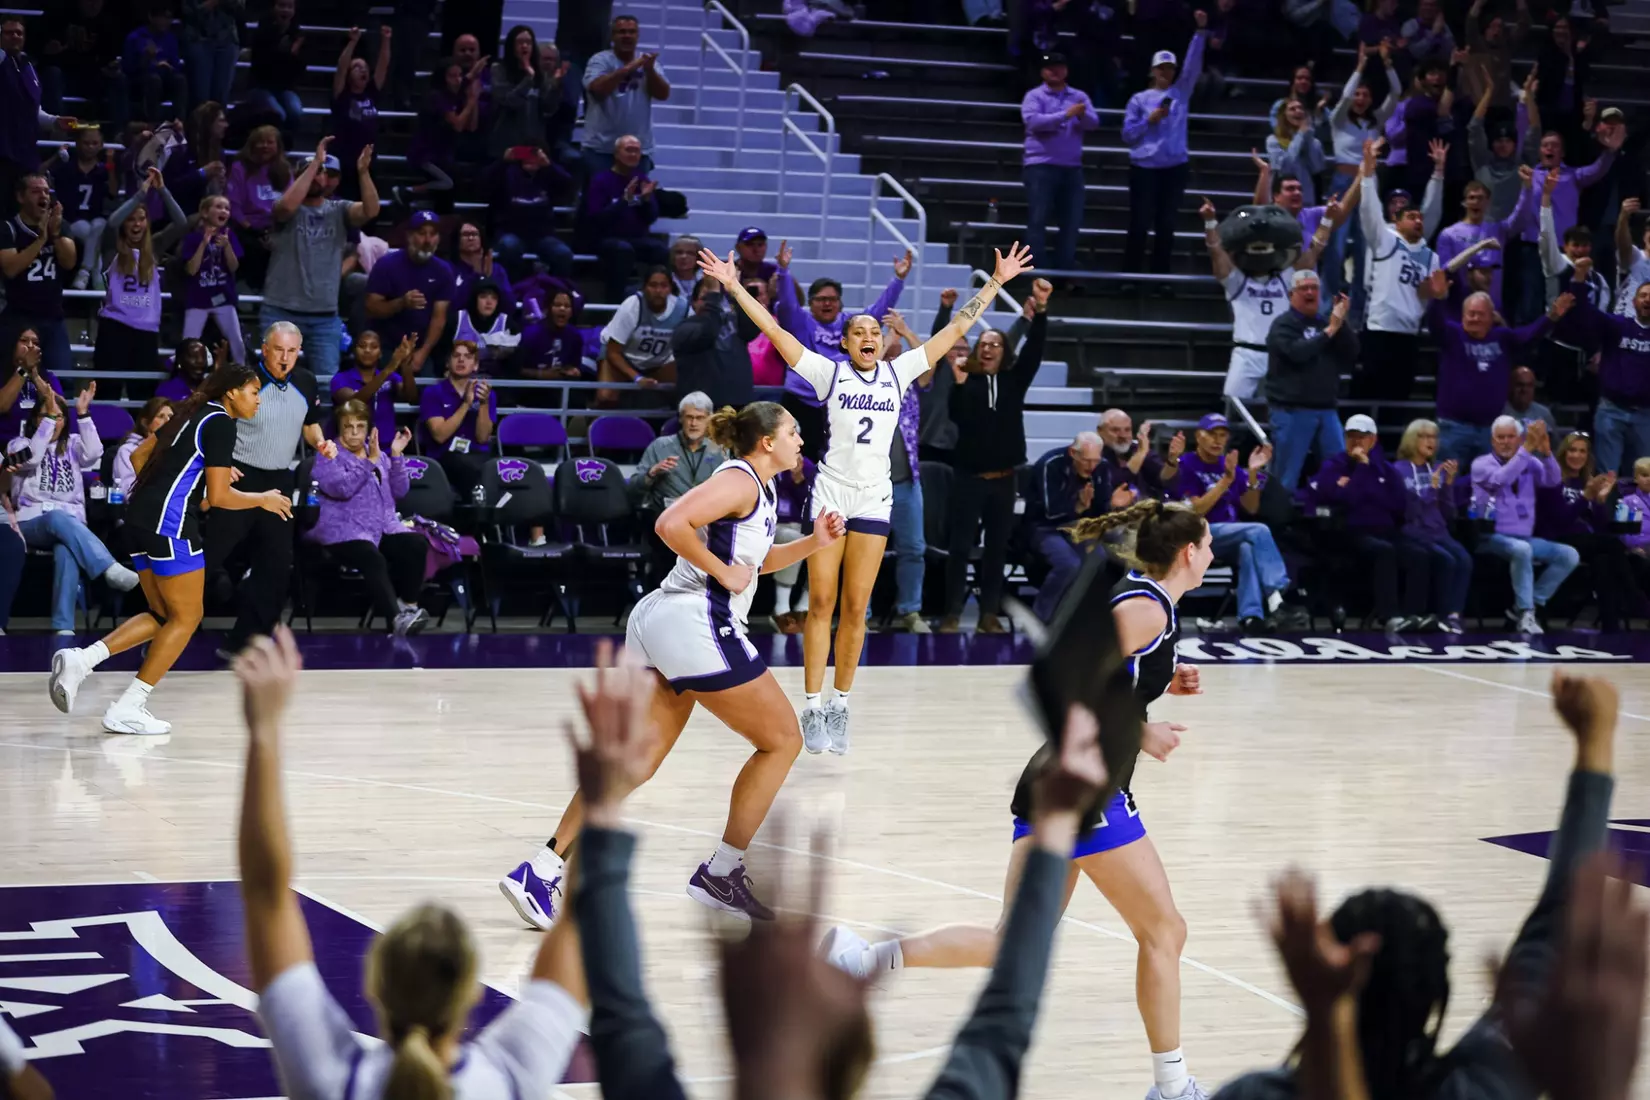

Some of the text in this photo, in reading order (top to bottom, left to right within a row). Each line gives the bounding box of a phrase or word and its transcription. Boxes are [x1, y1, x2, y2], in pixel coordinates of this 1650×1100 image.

[78, 183, 93, 210] 7
[27, 256, 56, 282] 24
[638, 337, 667, 357] 50
[838, 393, 895, 412] Wildcats
[856, 416, 874, 444] 2
[1175, 637, 1634, 661] ildcats
